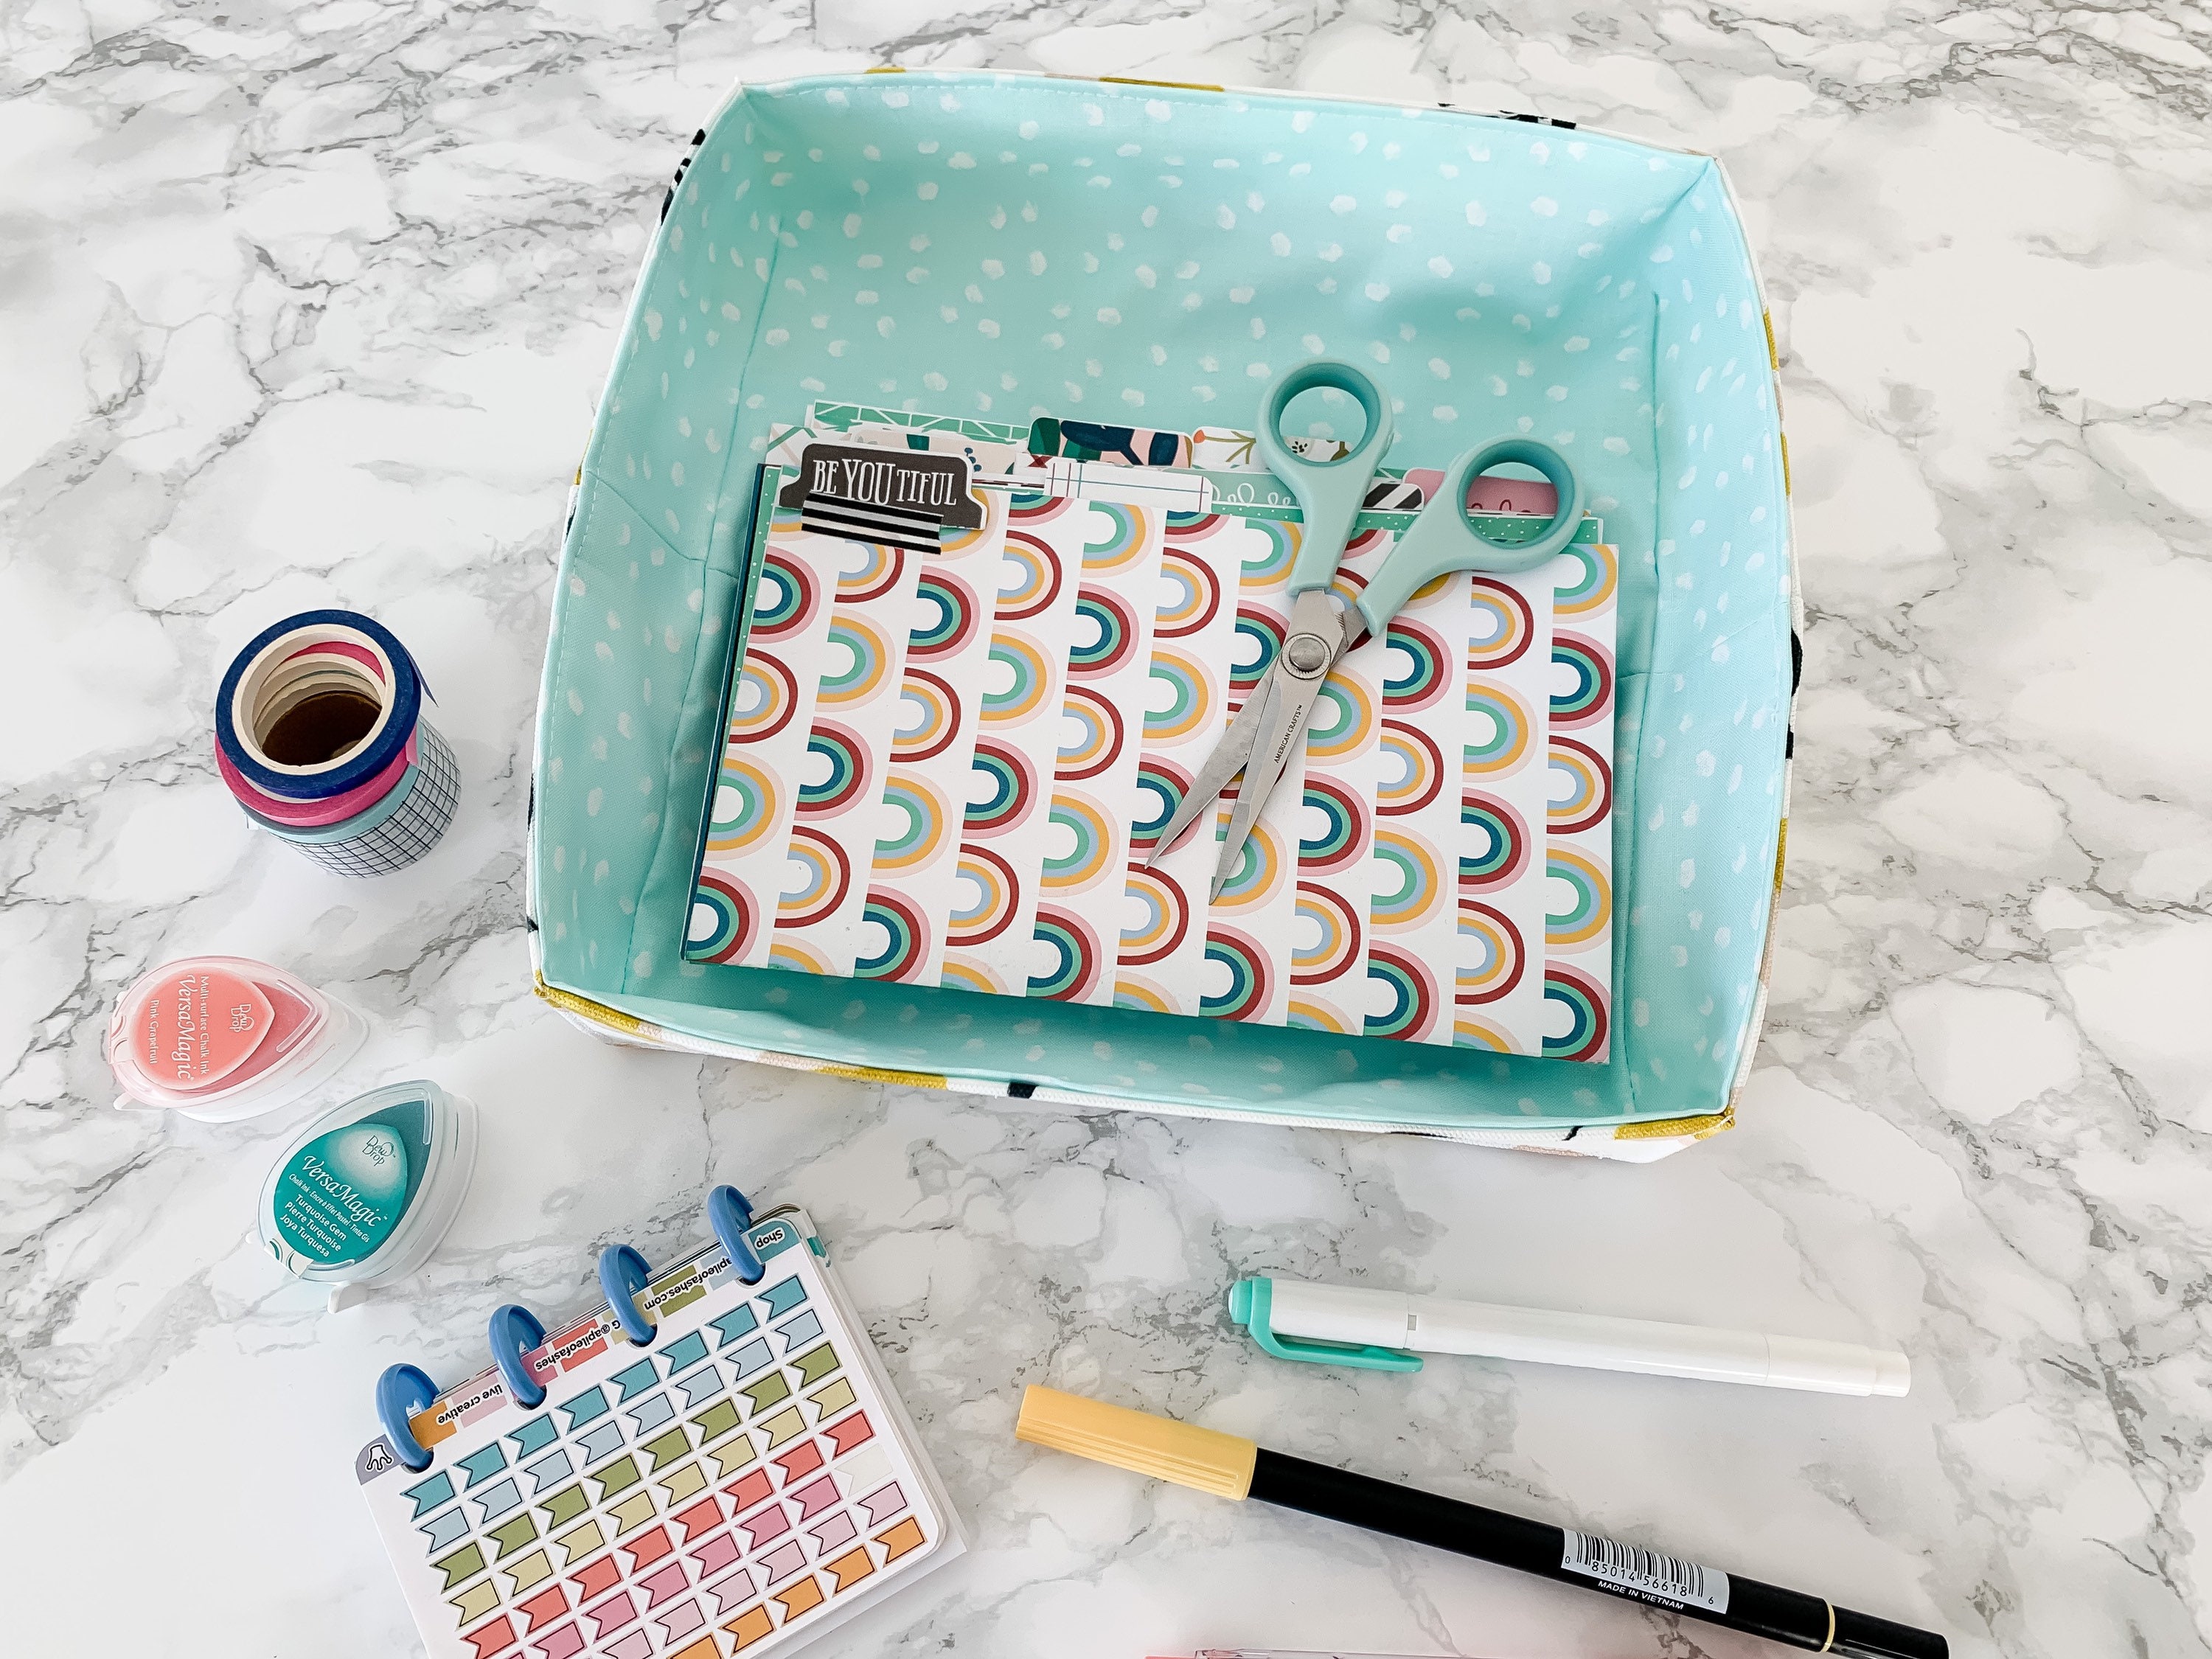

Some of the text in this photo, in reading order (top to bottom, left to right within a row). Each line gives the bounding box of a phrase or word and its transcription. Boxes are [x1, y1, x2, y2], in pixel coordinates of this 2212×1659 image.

[1273, 732, 1291, 764] AMERICAN
[147, 998, 160, 1065] Pink Grapefruit
[229, 1003, 254, 1033] Dew Drop
[200, 1032, 210, 1059] Chalk
[200, 1060, 210, 1075] Ink
[361, 1135, 394, 1166] Dew Drop
[288, 1173, 303, 1188] Chalk
[301, 1182, 310, 1193] Ink
[310, 1191, 324, 1205] Encre
[335, 1211, 350, 1226] Pastel
[350, 1223, 362, 1237] Tinta
[295, 1194, 347, 1241] Turquoise Gem
[280, 1214, 330, 1258] Joya Turquesa
[285, 1202, 341, 1252] Pierre Turquoise
[756, 1229, 783, 1248] Shop
[535, 1324, 611, 1370] @apileofashes
[438, 1384, 503, 1423] live creative
[1598, 1580, 1684, 1610] MADE IN VIETNAM
